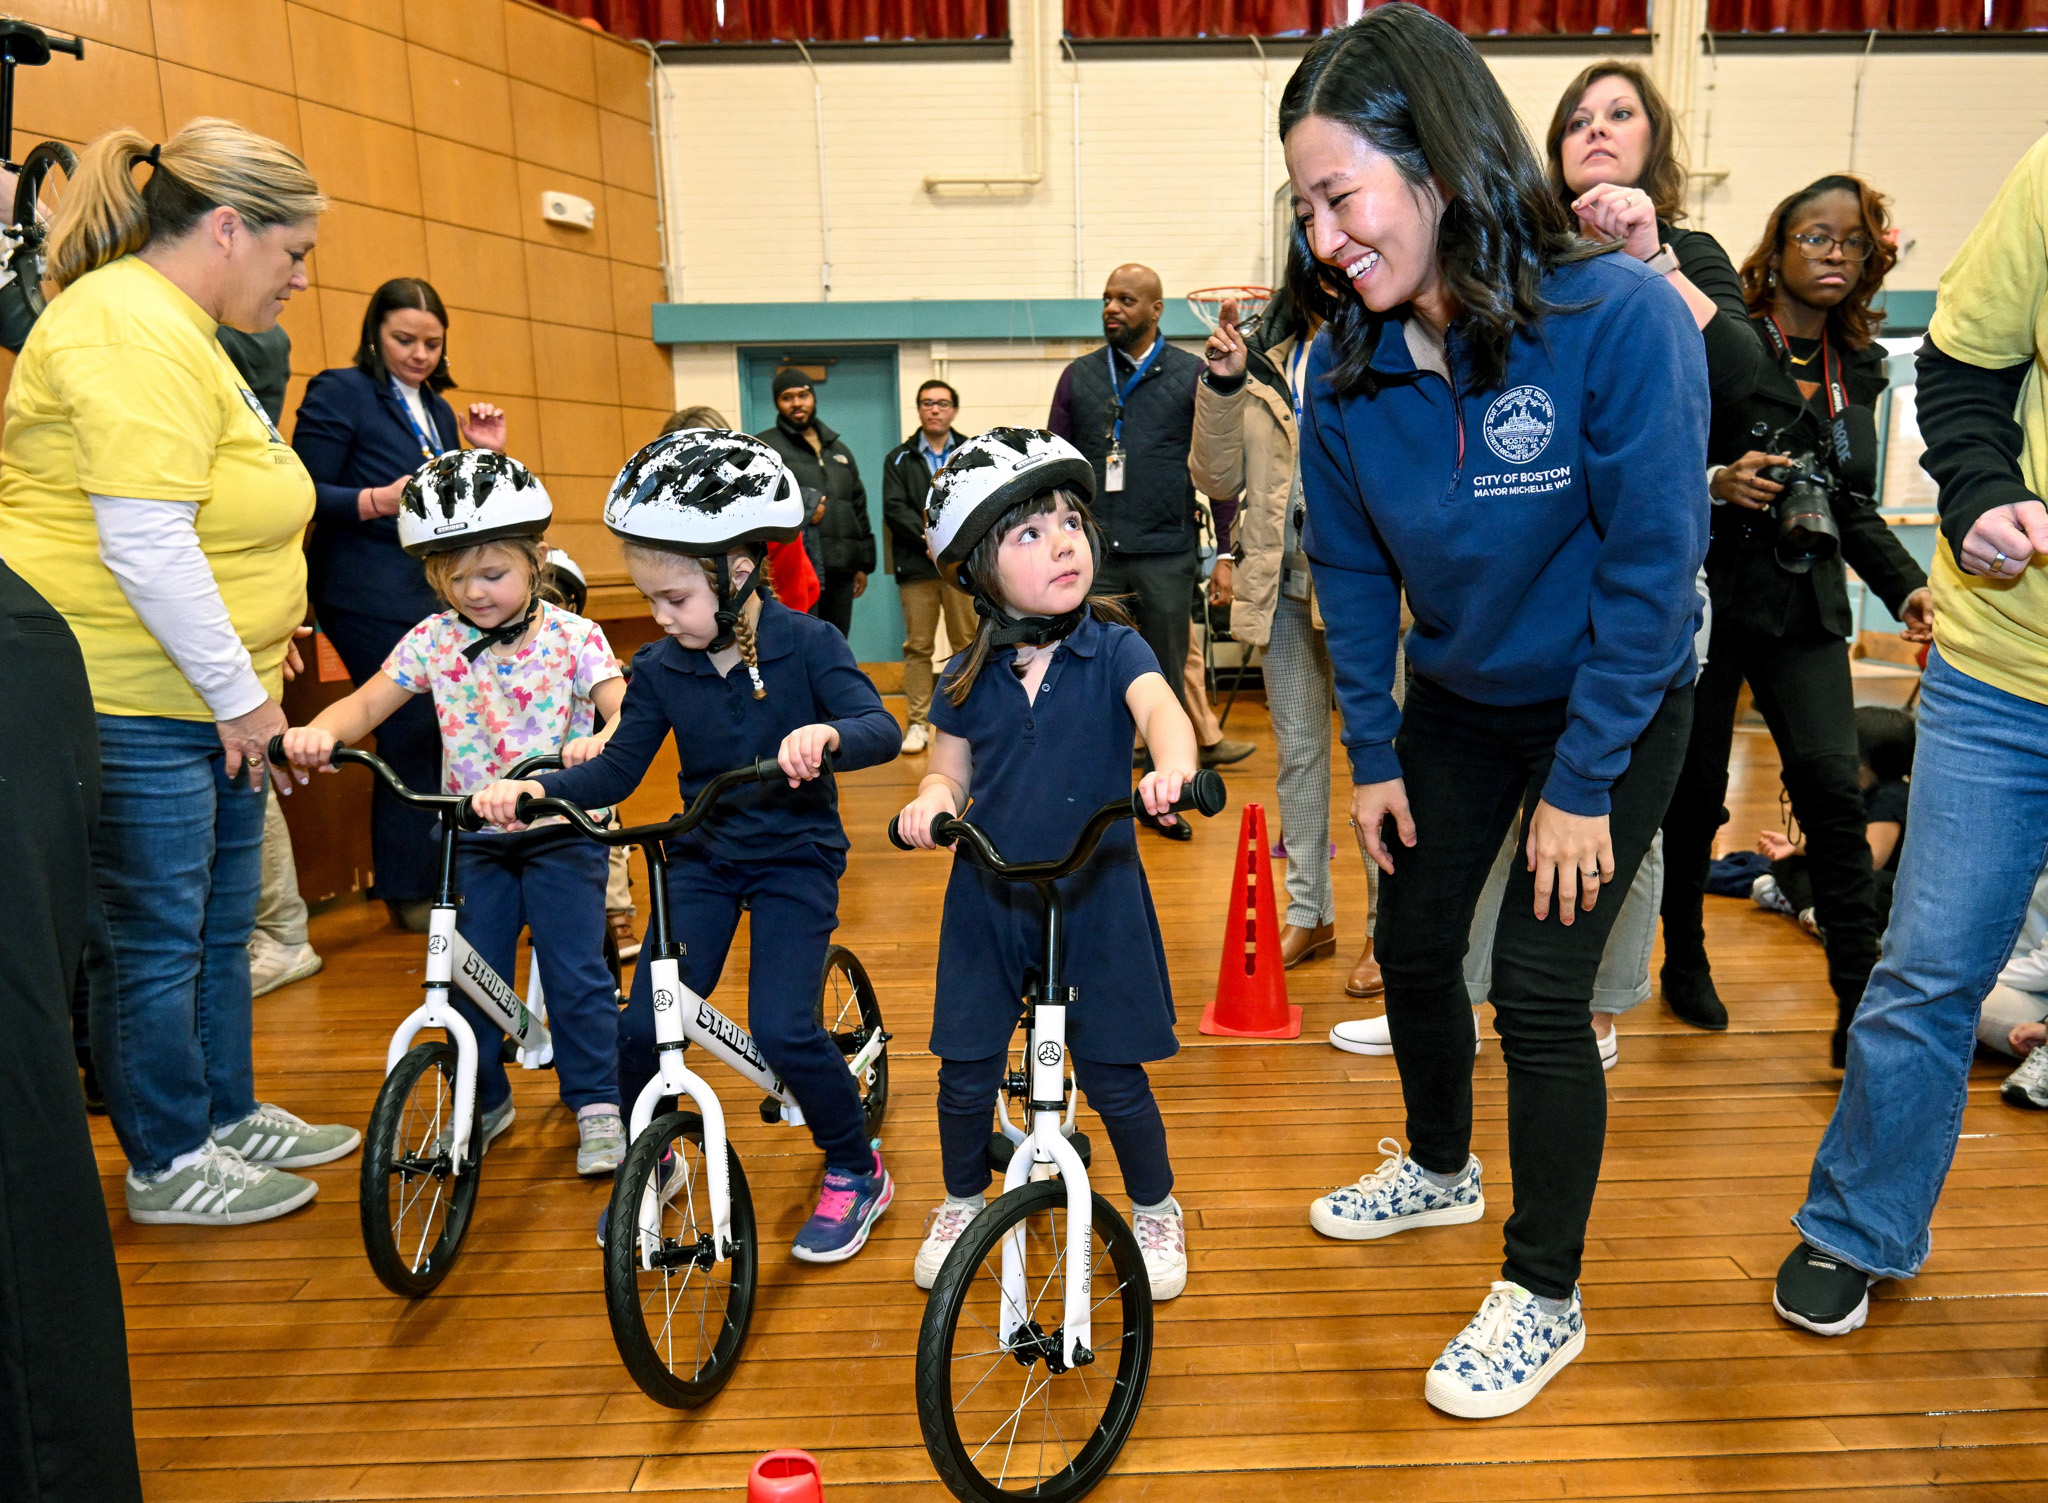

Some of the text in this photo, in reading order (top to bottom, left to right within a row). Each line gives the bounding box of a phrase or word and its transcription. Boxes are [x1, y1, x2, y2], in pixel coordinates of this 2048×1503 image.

[1487, 407, 1498, 424] SICUT
[1496, 389, 1523, 408] PATRIBUS
[1534, 390, 1547, 403] DEUS
[1502, 436, 1539, 446] BOSTONIA
[1473, 465, 1571, 486] CITY OF BOSTON
[1474, 478, 1571, 498] MAYOR MICHELLE WU
[463, 950, 518, 1019] STRIDER
